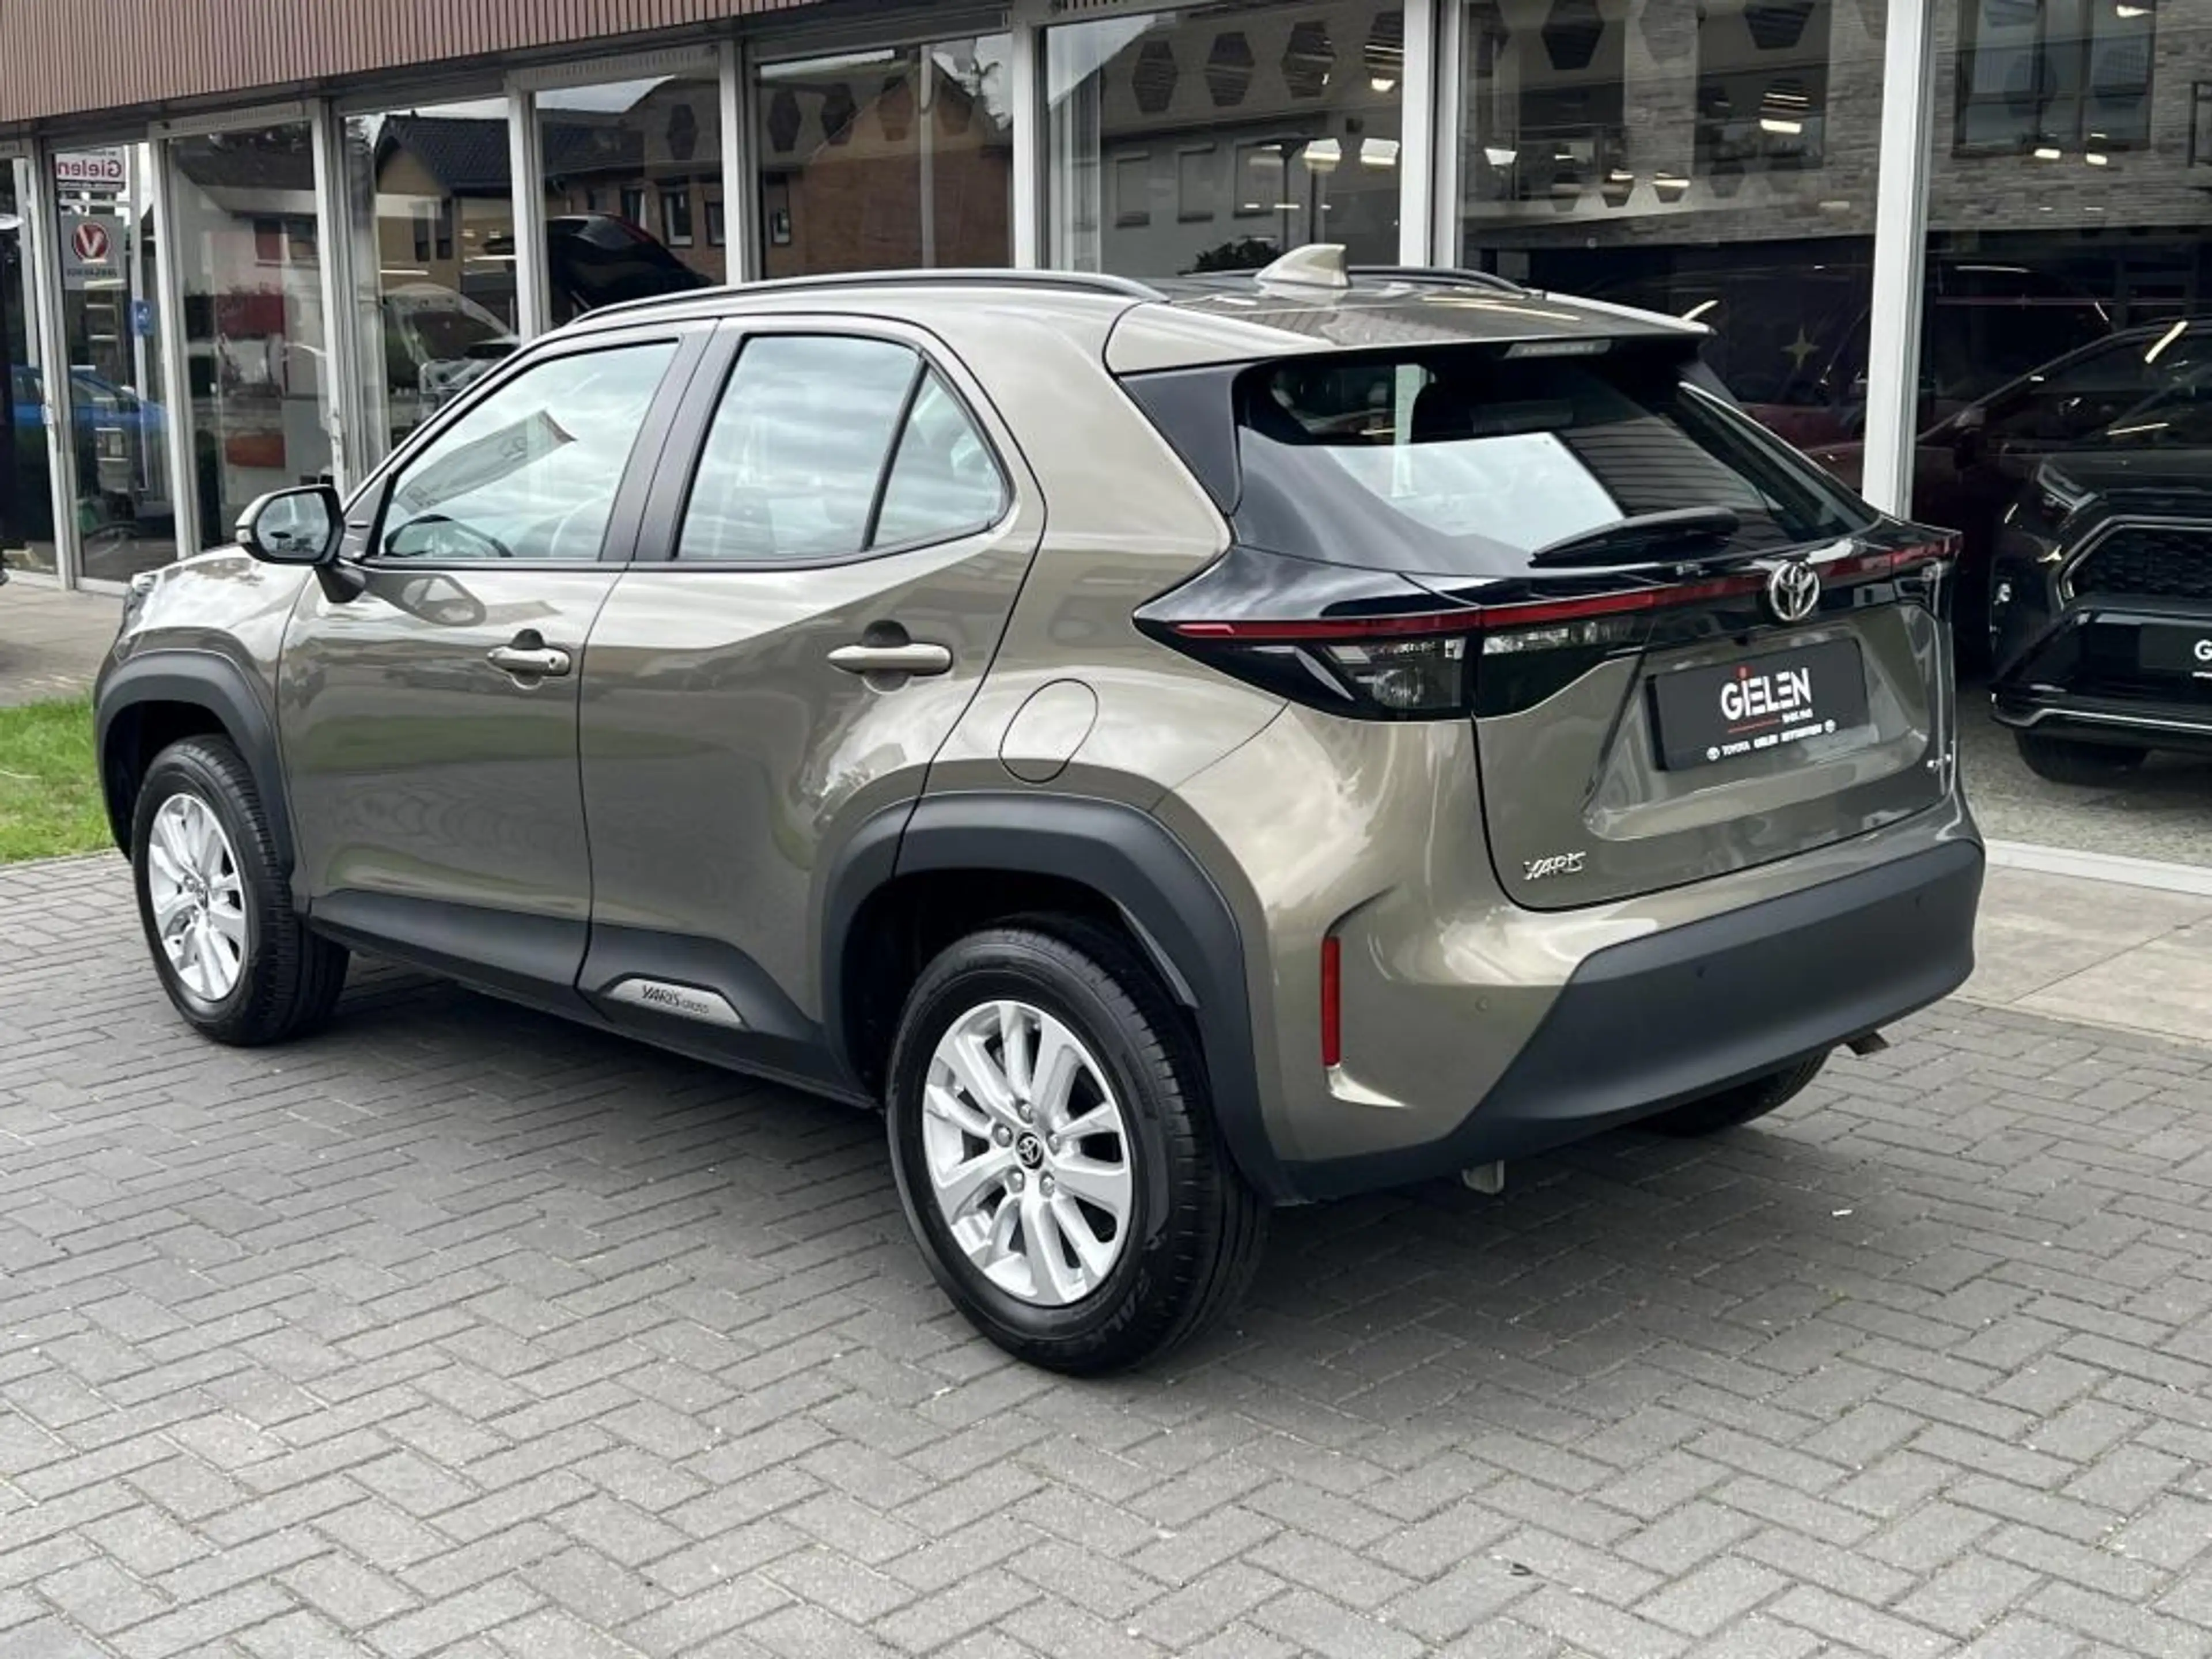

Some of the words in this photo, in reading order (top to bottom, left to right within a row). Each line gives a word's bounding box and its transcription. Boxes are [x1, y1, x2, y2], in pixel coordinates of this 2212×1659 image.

[1721, 666, 1812, 721] GIELEN
[1522, 851, 1586, 880] YARIS
[642, 984, 680, 1007] YARIS
